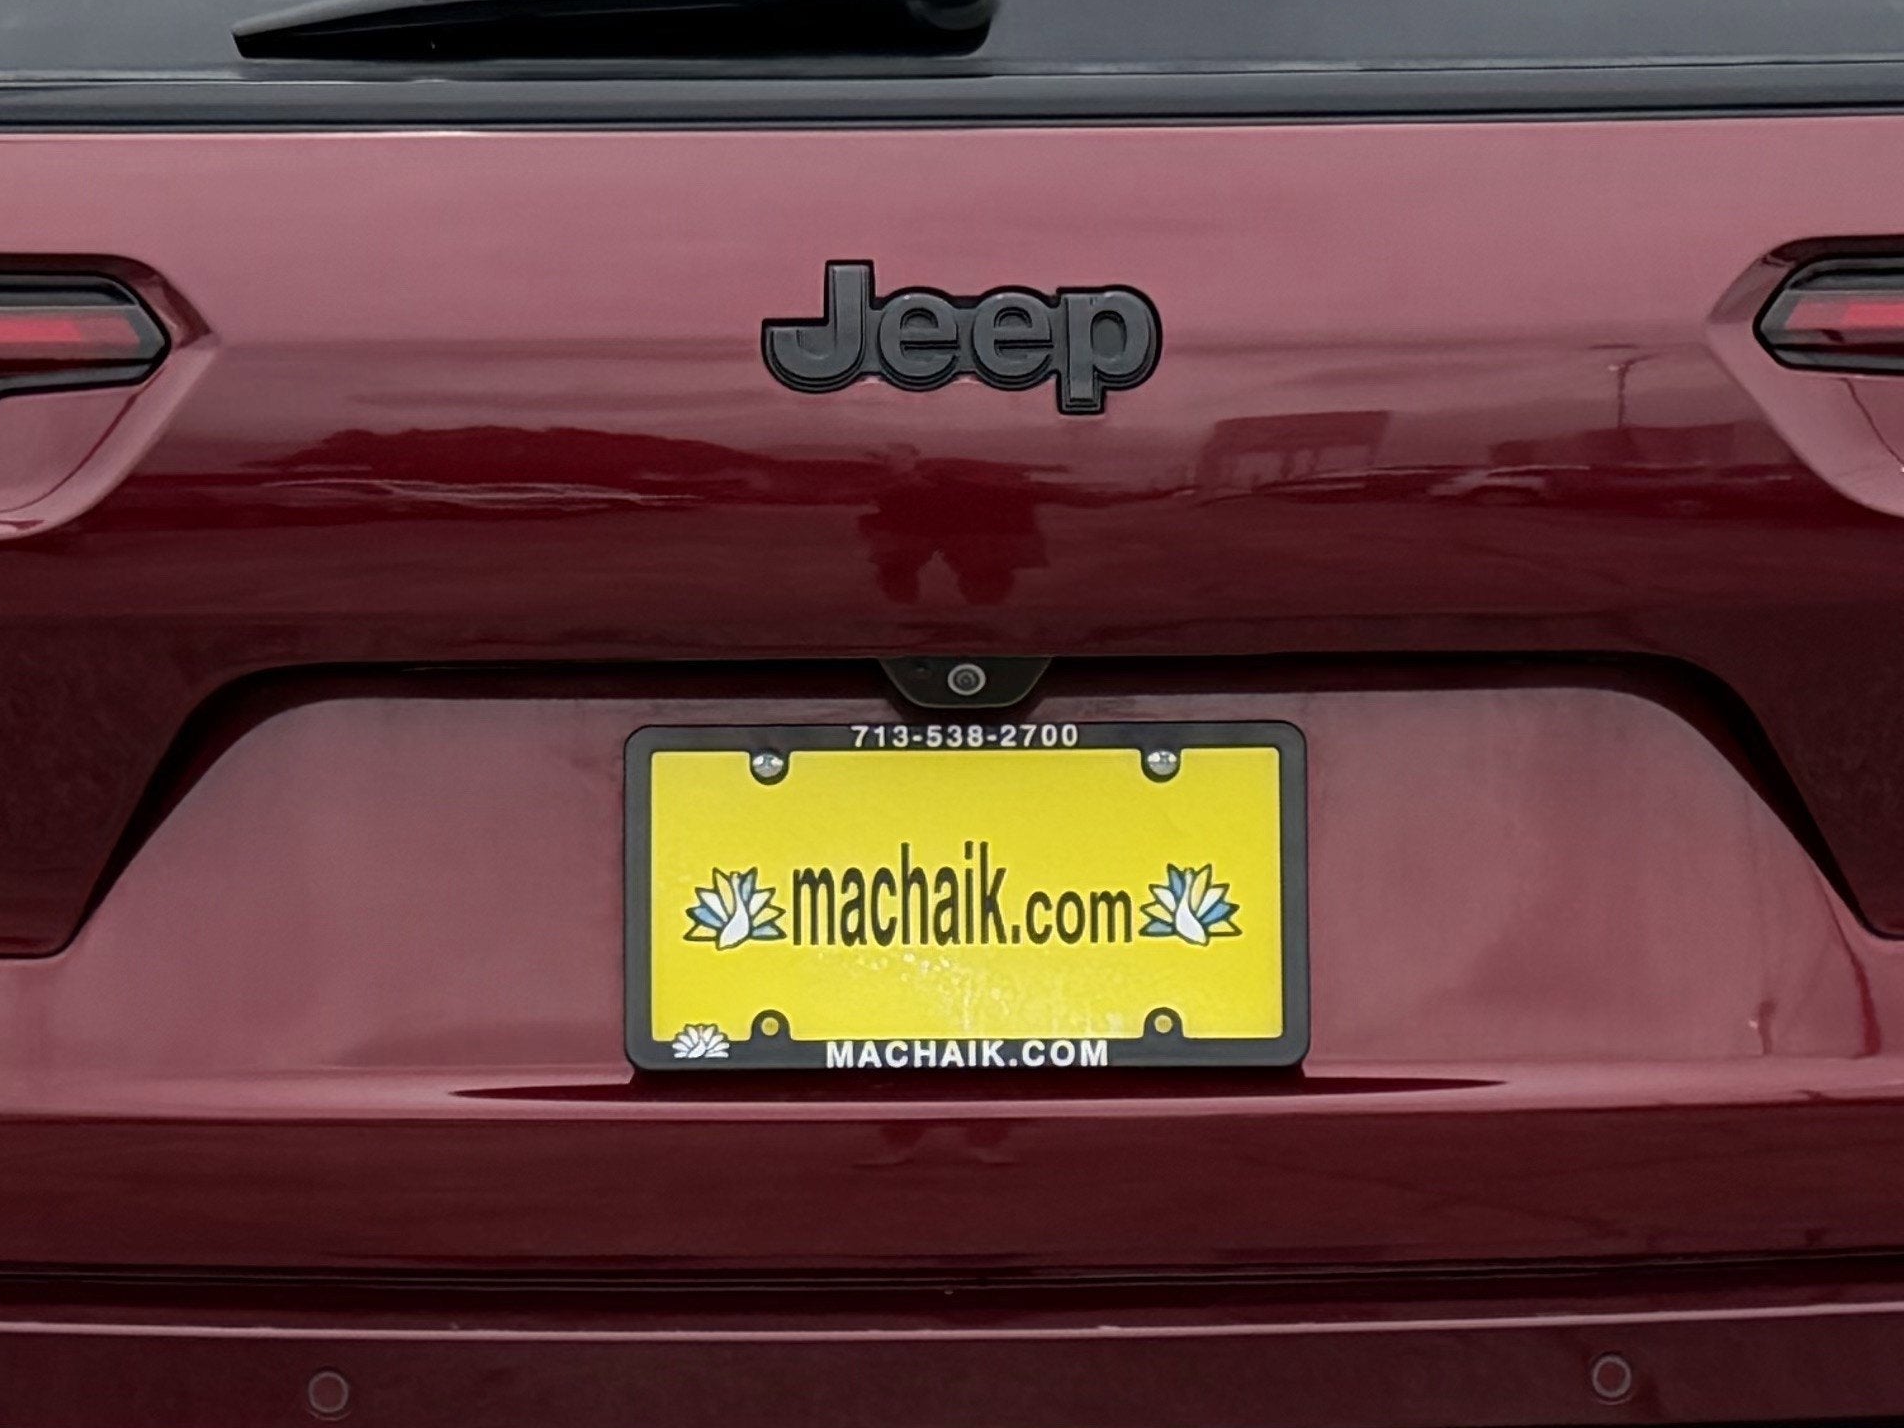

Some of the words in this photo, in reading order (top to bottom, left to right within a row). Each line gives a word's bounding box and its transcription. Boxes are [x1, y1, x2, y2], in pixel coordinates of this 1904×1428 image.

[761, 259, 1163, 415] Jeep
[851, 724, 1079, 748] 713-538-2700
[791, 841, 1134, 947] machaik.com
[826, 1040, 1110, 1069] MACHAIK.COM
